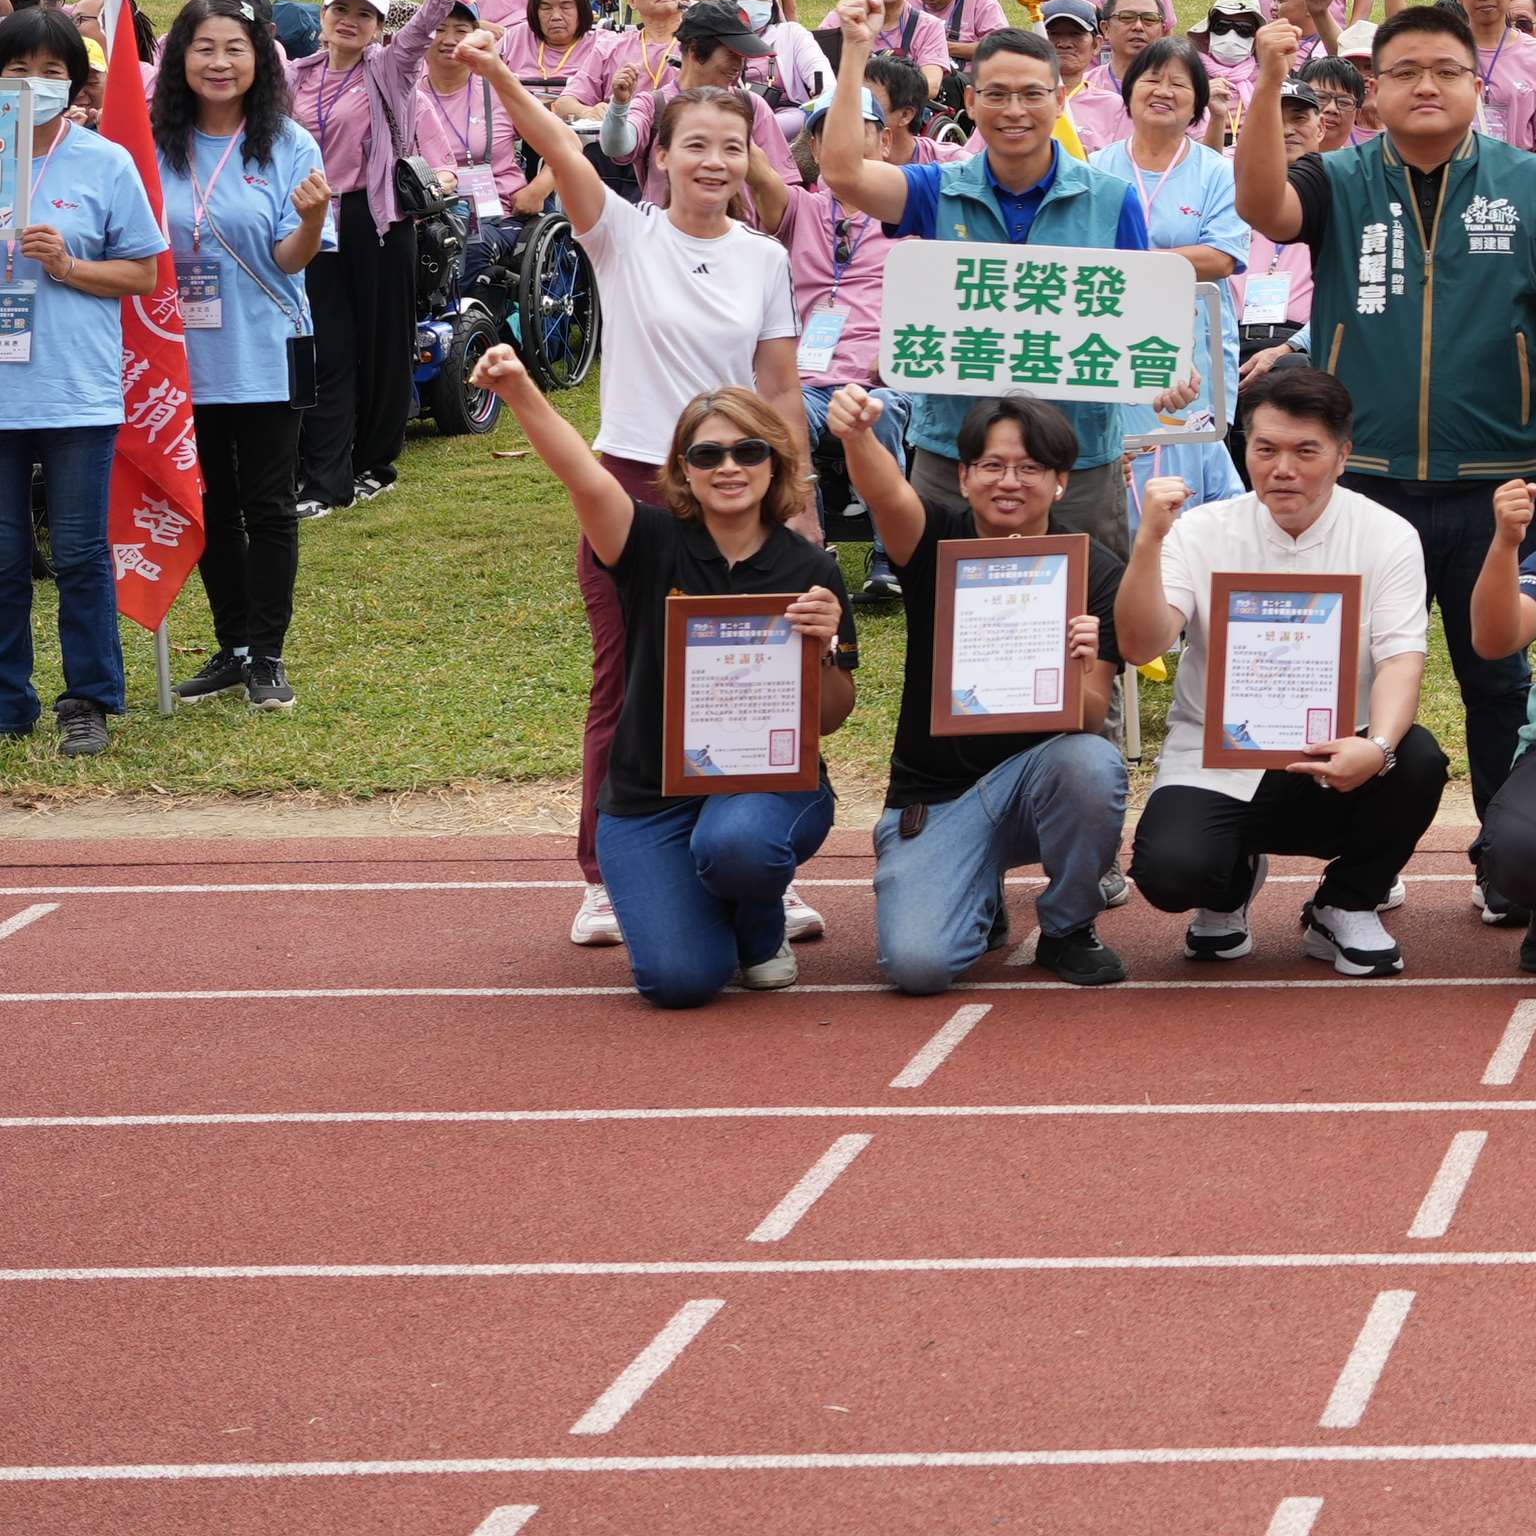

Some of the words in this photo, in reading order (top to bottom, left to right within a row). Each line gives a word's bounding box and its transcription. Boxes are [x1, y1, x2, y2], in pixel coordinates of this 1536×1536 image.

[954, 257, 1129, 320] 張榮發
[1356, 222, 1388, 314] 黃耀宗
[890, 321, 1182, 391] 慈善基金會
